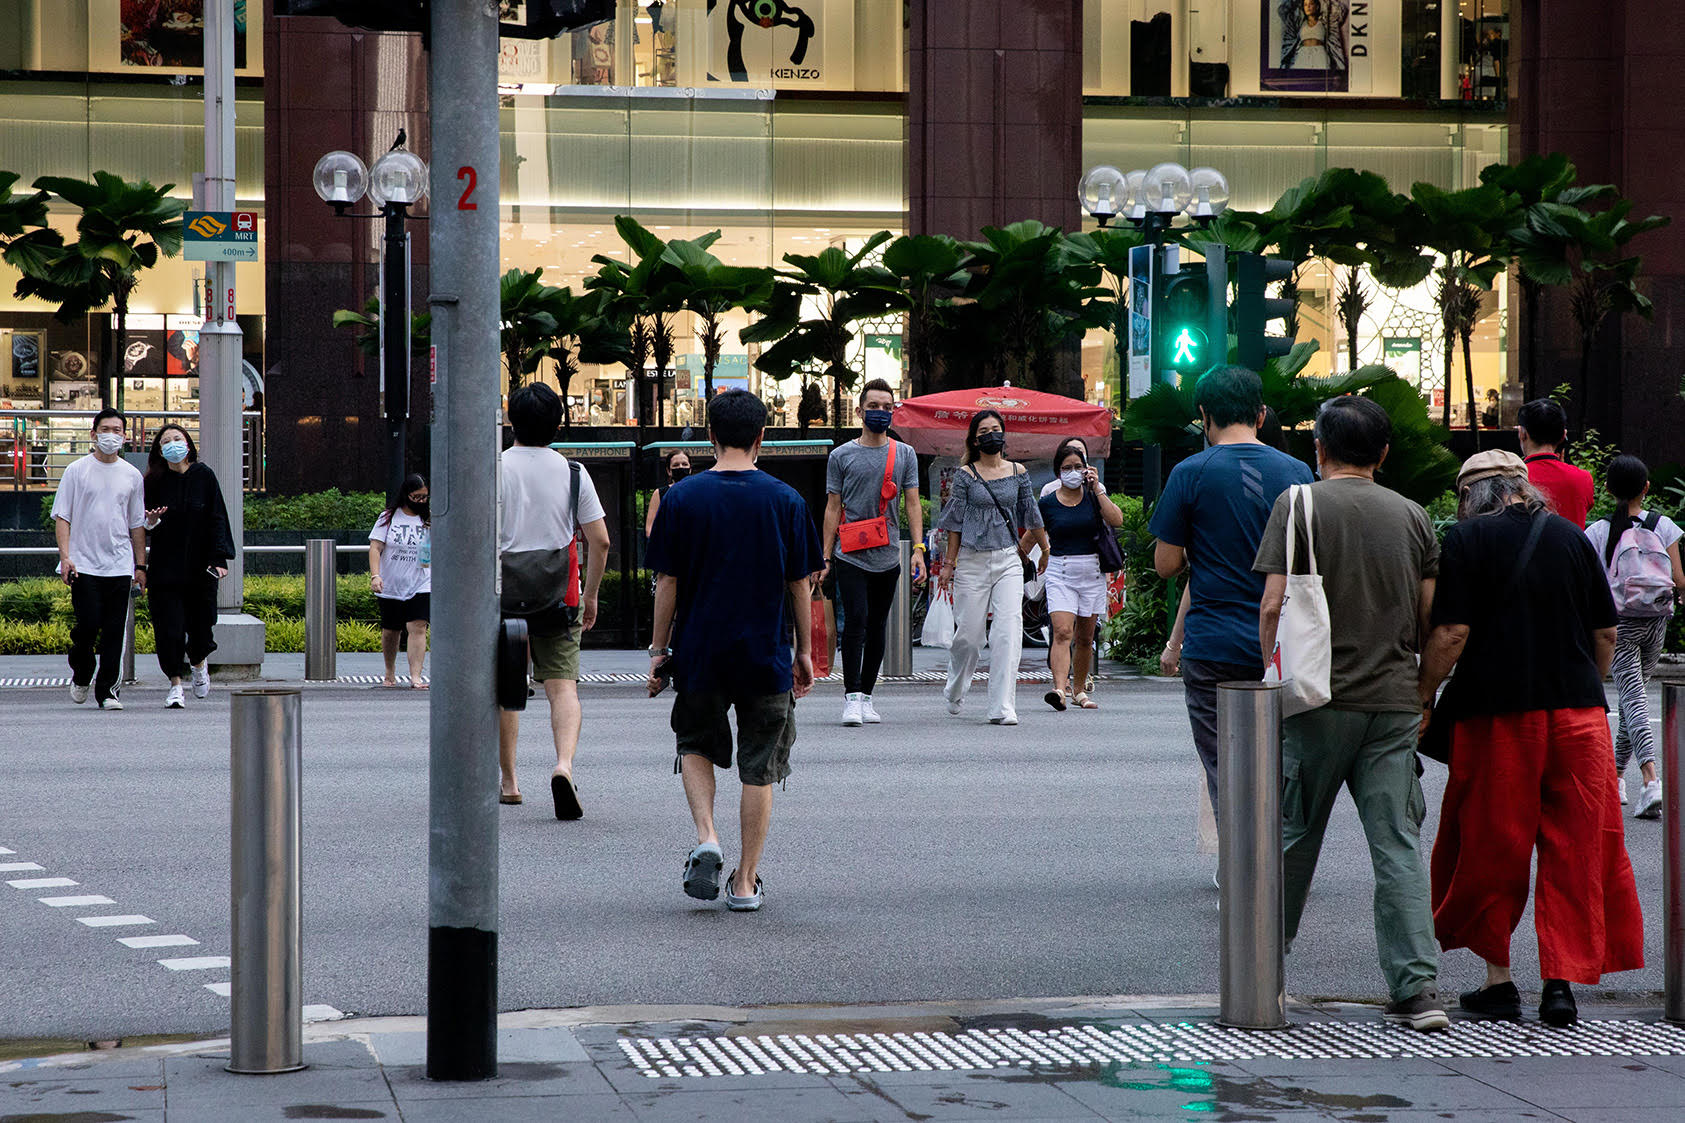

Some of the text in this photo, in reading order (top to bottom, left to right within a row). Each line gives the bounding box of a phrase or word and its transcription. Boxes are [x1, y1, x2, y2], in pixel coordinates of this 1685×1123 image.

[770, 68, 820, 79] KENZO
[457, 165, 478, 211] 2
[235, 232, 254, 240] MRT
[222, 248, 245, 256] 400m
[576, 447, 627, 457] PAYPHONE
[684, 446, 715, 456] AYPHO
[776, 445, 825, 455] PAYPHONE
